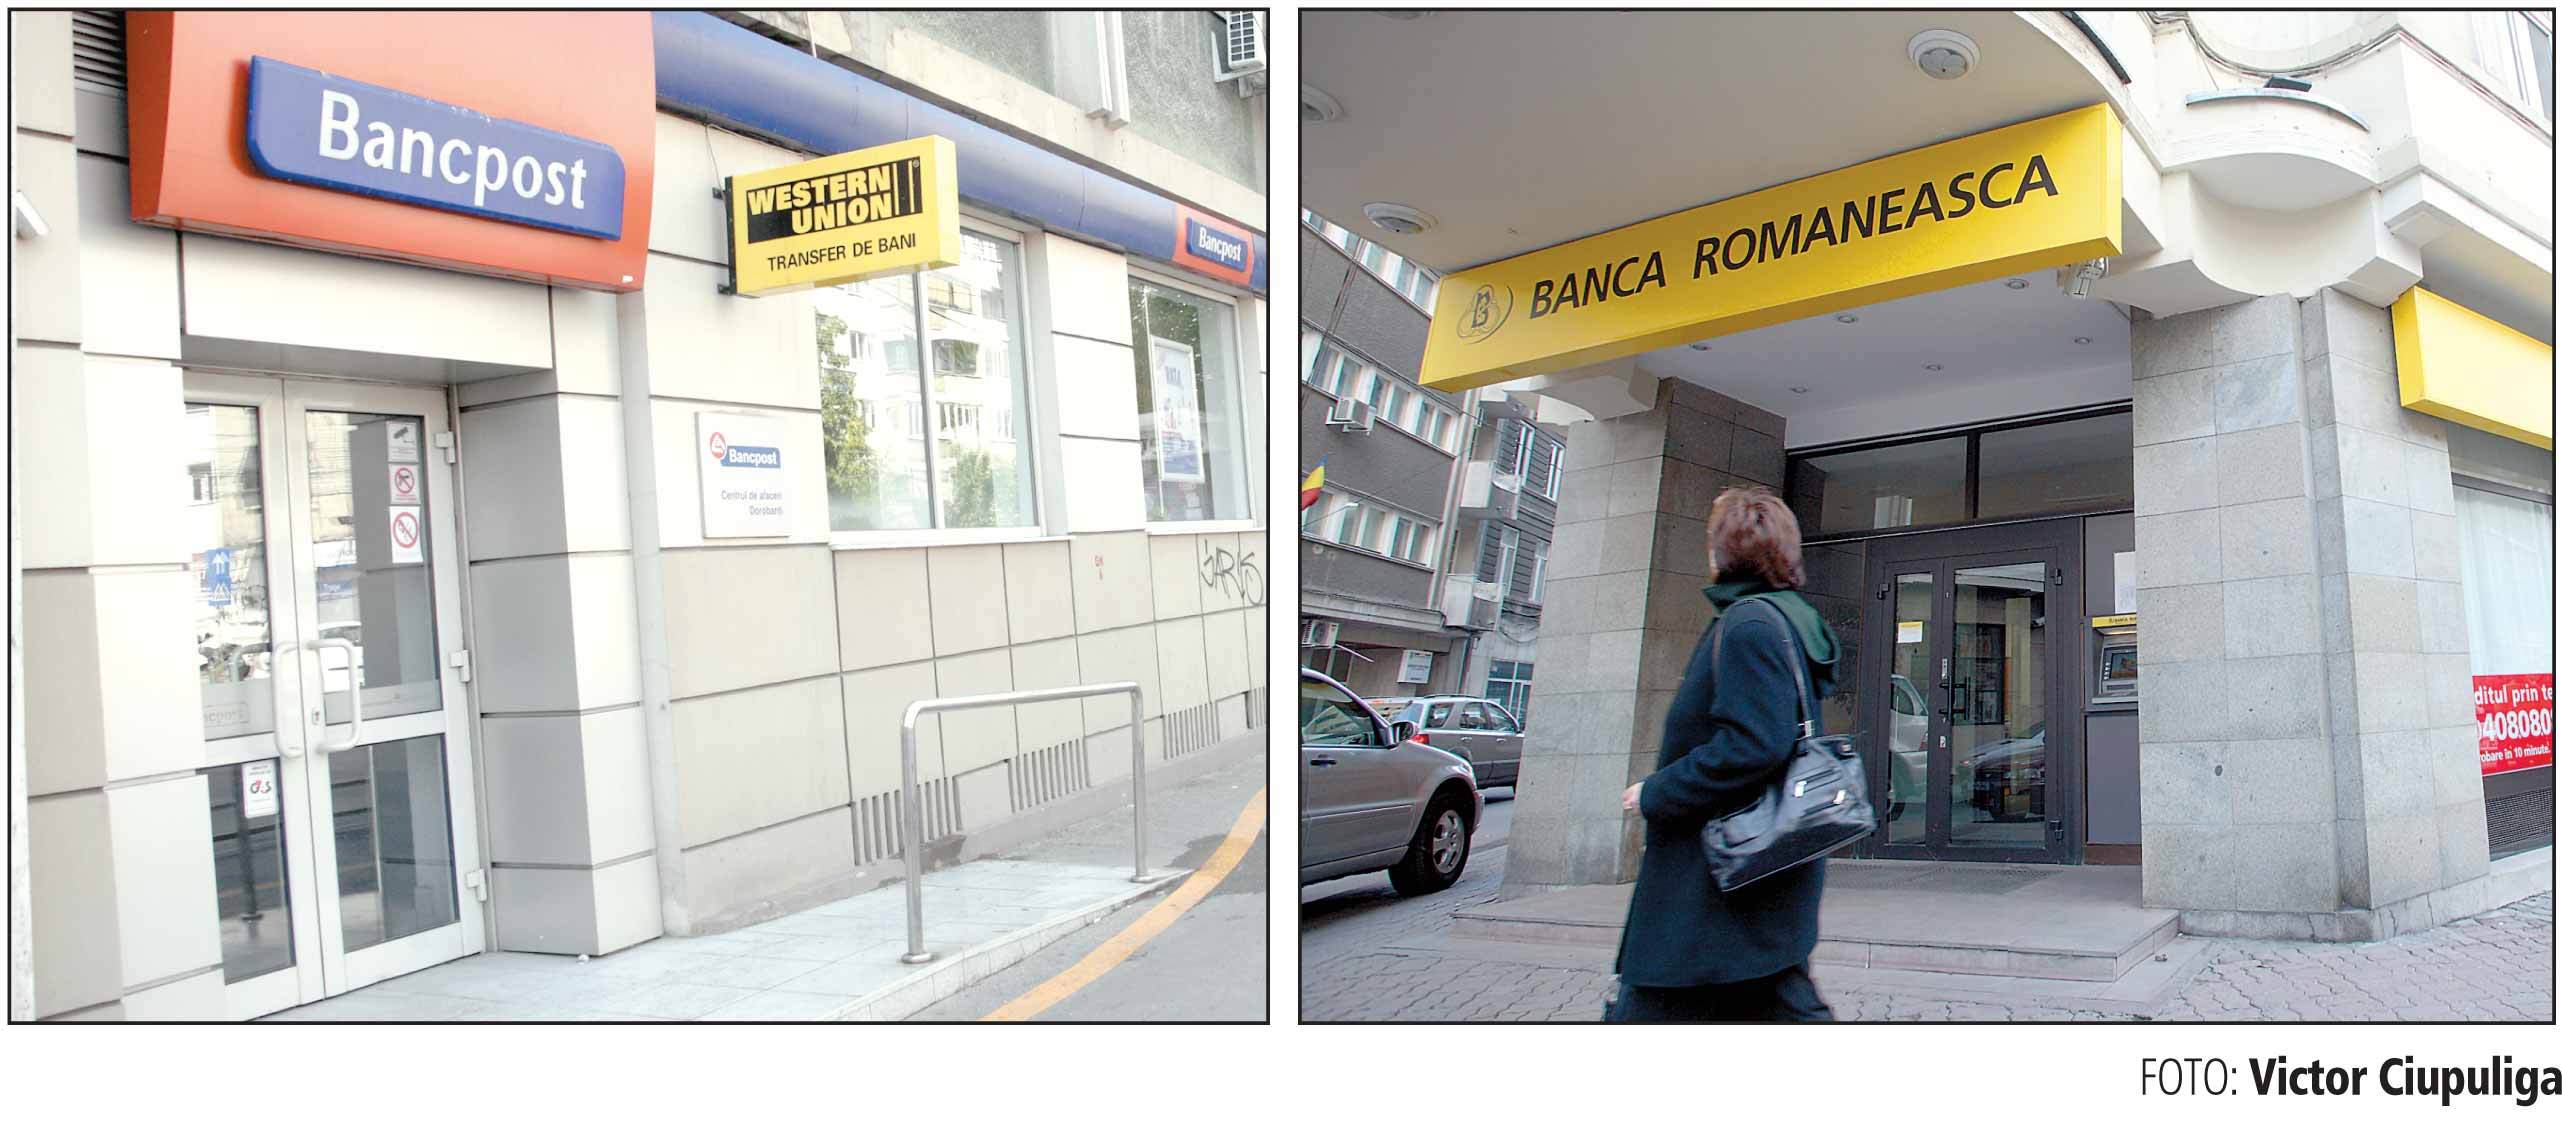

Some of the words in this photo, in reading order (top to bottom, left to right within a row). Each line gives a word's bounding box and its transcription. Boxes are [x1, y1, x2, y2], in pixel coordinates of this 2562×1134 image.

[319, 89, 587, 209] Bancpost
[748, 163, 893, 216] WESTERN
[792, 191, 893, 235] UNION
[768, 245, 846, 272] TRANSFER
[853, 239, 873, 257] DE
[878, 232, 917, 253] BANI
[1198, 226, 1242, 262] Bancpost
[1530, 251, 1667, 320] BANCA
[1693, 154, 2060, 280] ROMANEASCA
[728, 448, 778, 467] Bancpost
[721, 490, 747, 501] Centrul
[749, 490, 758, 501] de
[2512, 683, 2539, 708] prin
[2514, 746, 2523, 758] 10
